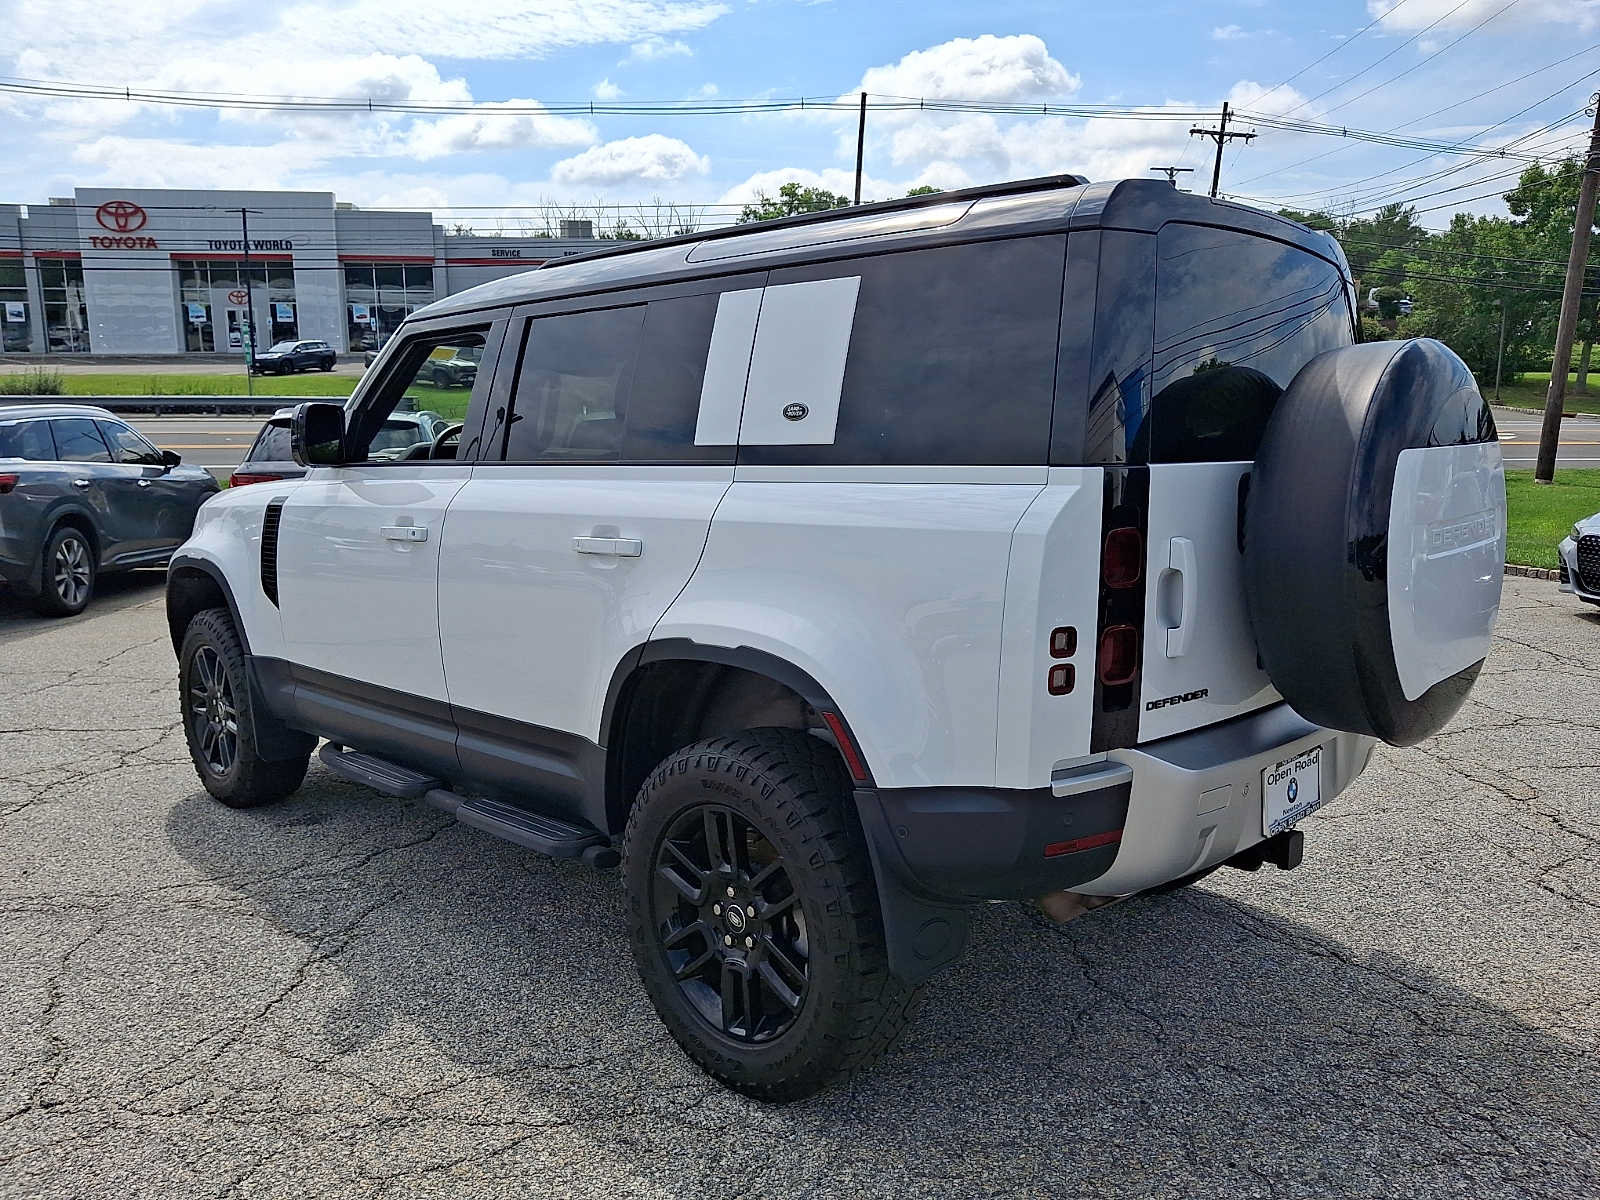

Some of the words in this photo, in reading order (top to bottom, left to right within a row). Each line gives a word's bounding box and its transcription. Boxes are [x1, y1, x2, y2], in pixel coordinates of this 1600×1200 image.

[89, 236, 158, 249] TOYOTA
[208, 239, 251, 251] TOYOTA
[253, 239, 293, 251] WORLD
[491, 249, 521, 257] SERVICE
[1146, 689, 1208, 711] DEFENDER
[1267, 767, 1292, 785] Open
[1294, 752, 1318, 773] Road
